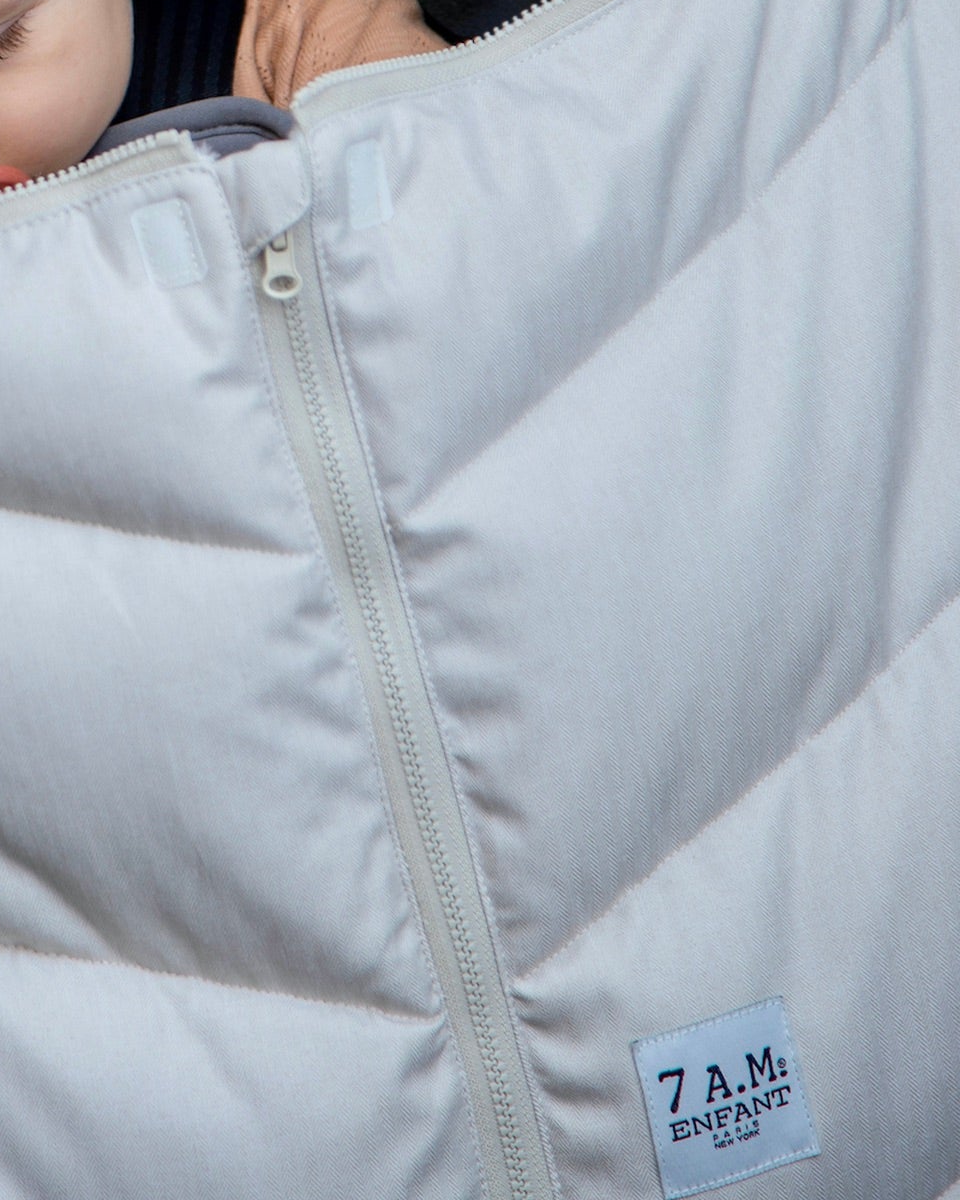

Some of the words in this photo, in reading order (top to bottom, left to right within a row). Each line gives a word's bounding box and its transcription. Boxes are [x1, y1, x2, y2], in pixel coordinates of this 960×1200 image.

[658, 1066, 685, 1114] 7
[669, 1084, 791, 1142] ENFANT
[713, 1119, 760, 1141] PARIS
[714, 1137, 735, 1150] NEW
[736, 1128, 761, 1144] YORK
